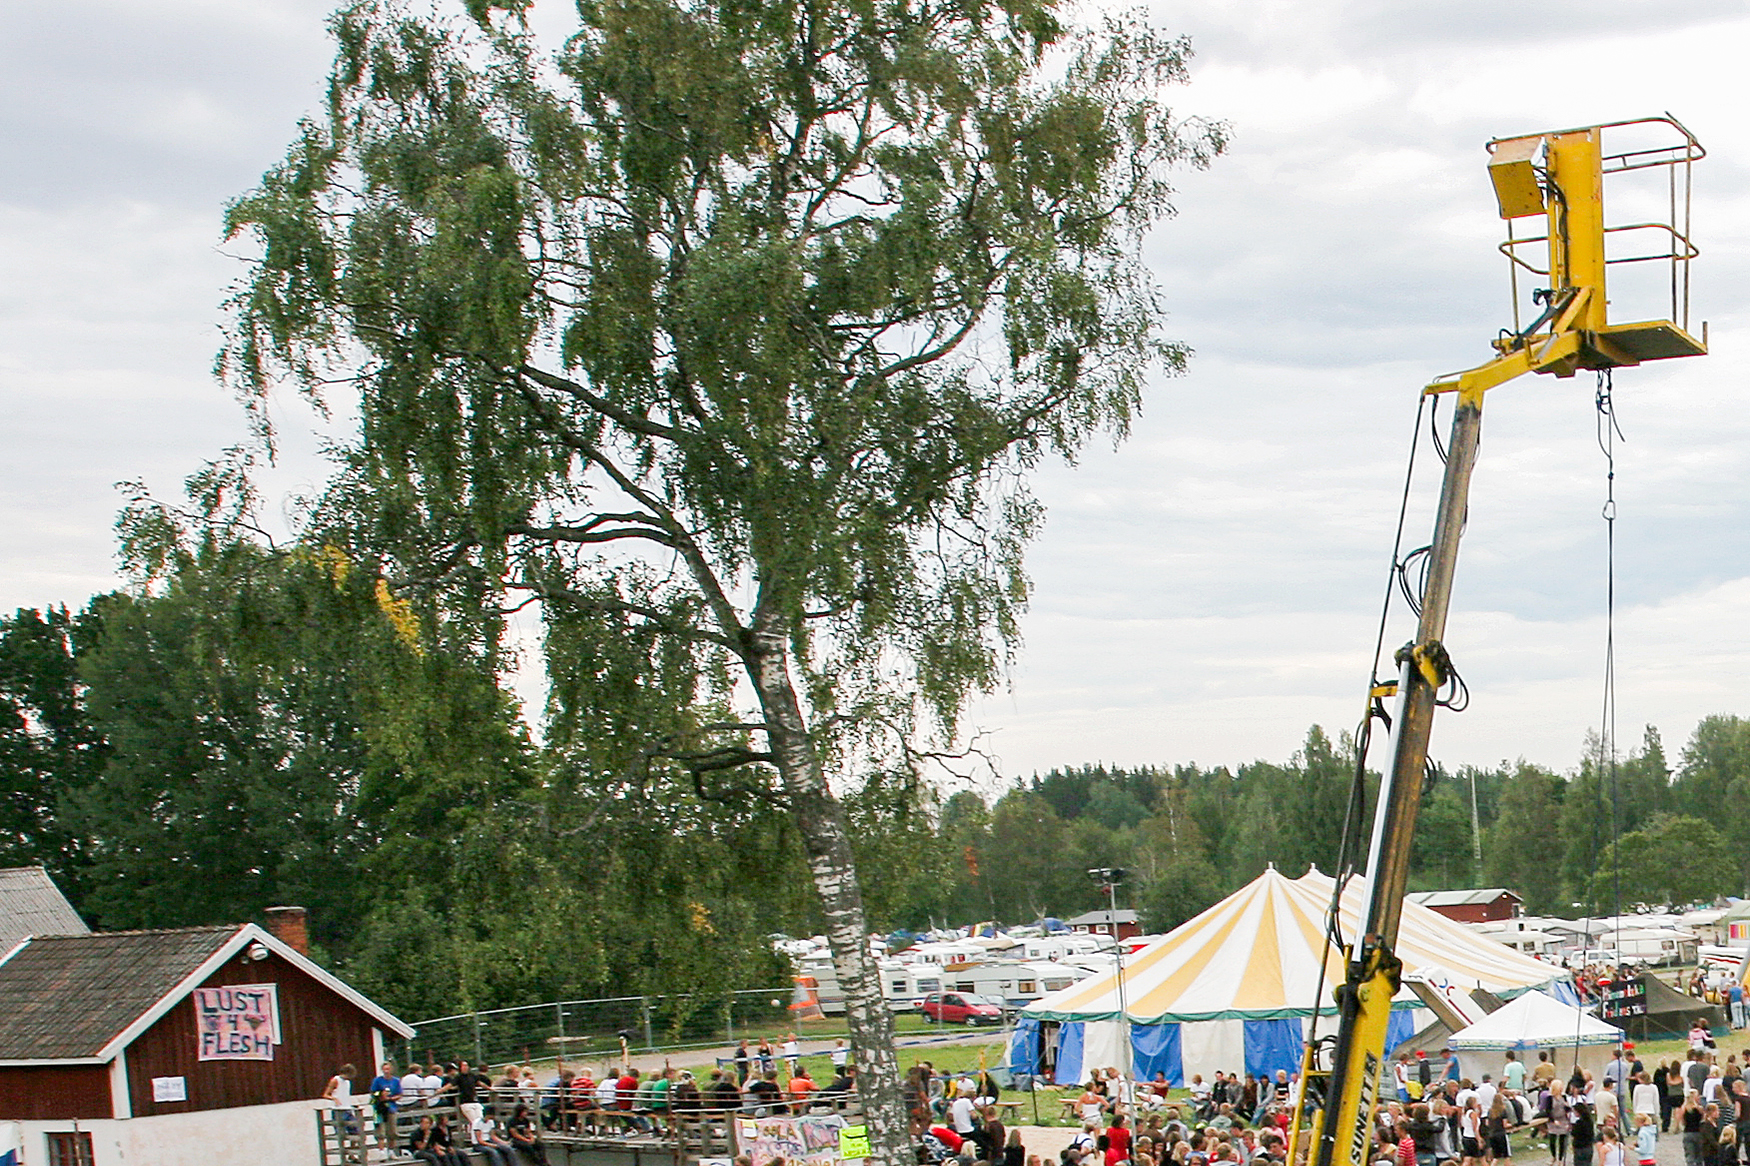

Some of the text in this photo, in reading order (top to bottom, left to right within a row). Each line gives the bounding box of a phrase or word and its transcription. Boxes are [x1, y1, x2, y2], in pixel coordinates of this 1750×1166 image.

[200, 990, 264, 1013] LUST
[227, 1014, 238, 1031] 4
[203, 1031, 270, 1055] FLESH
[1351, 1075, 1373, 1164] SUNETT
